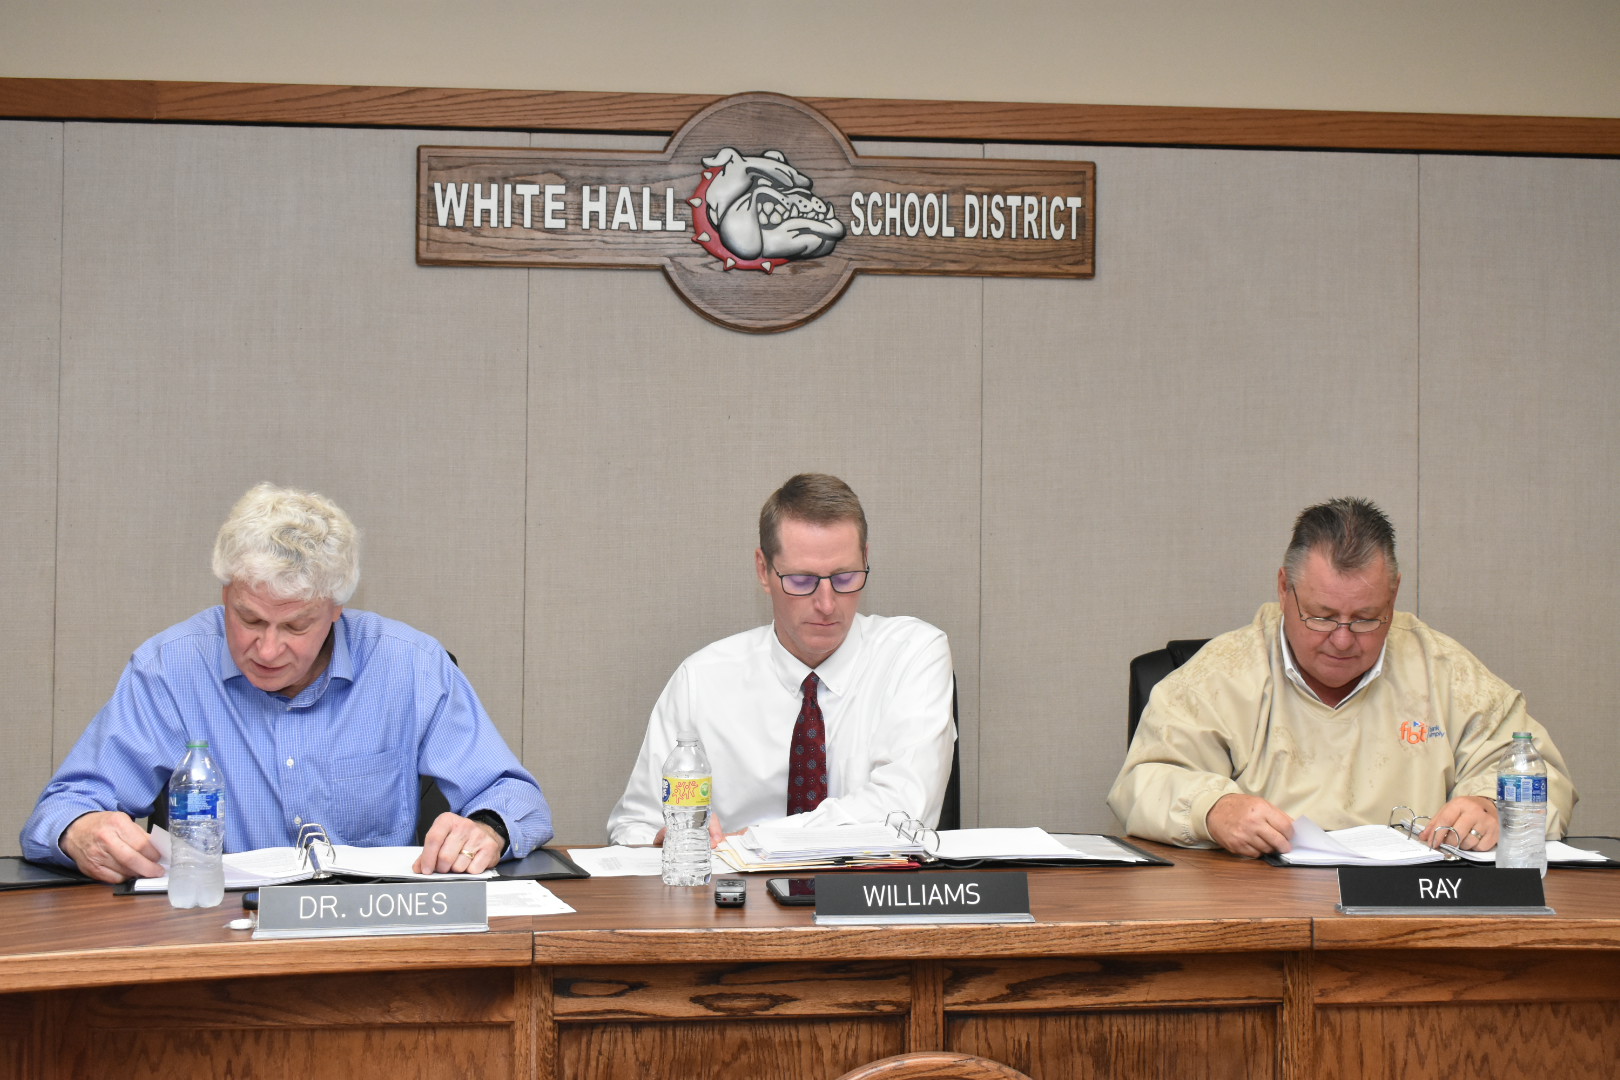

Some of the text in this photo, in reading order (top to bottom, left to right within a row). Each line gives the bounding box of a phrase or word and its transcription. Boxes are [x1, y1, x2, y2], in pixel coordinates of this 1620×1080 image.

[434, 182, 1082, 240] WHITE HALL SCHOOL DISTRICT
[1400, 721, 1428, 744] fbt
[862, 883, 981, 907] WILLIAMS
[1418, 878, 1462, 899] RAY
[299, 891, 448, 919] DR. JONES
